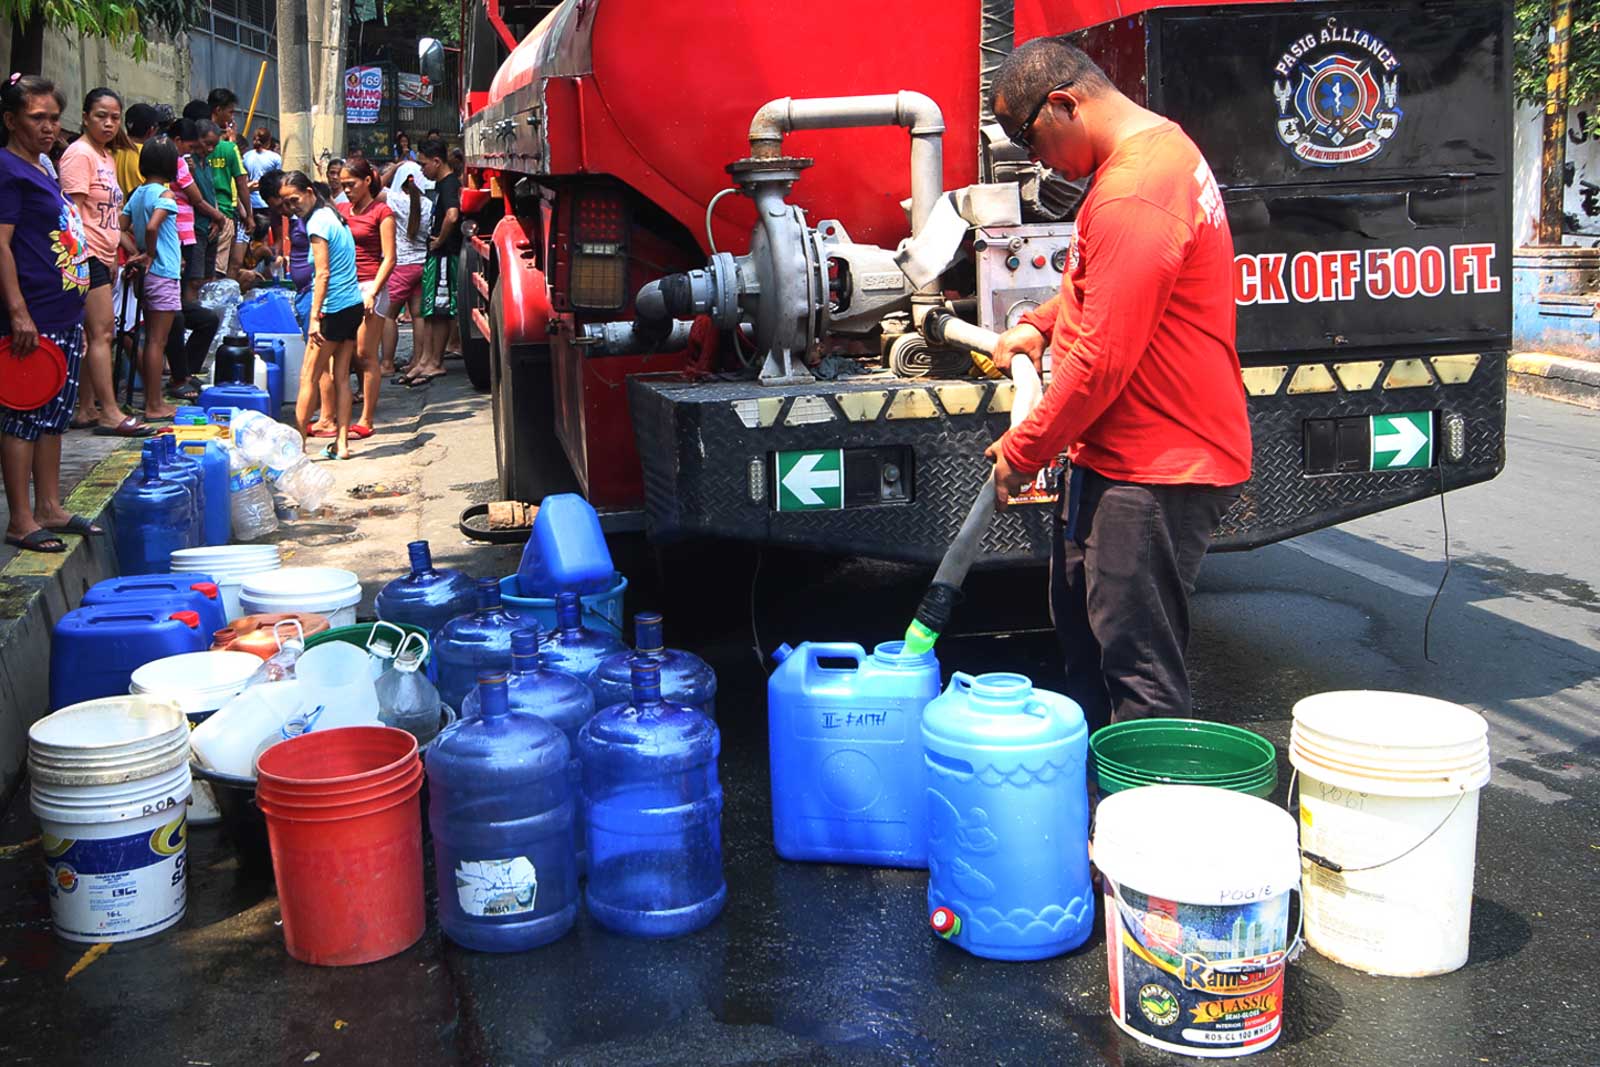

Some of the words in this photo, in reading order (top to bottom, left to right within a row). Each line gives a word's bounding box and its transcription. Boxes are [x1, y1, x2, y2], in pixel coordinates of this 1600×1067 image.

[1276, 34, 1317, 75] PASIG
[1320, 27, 1397, 71] ALLIANCE
[1291, 250, 1360, 302] OFF
[1364, 246, 1444, 298] 500
[1450, 243, 1500, 294] FT.
[1205, 993, 1273, 1018] CLASSIC
[1253, 1023, 1273, 1036] WHITE
